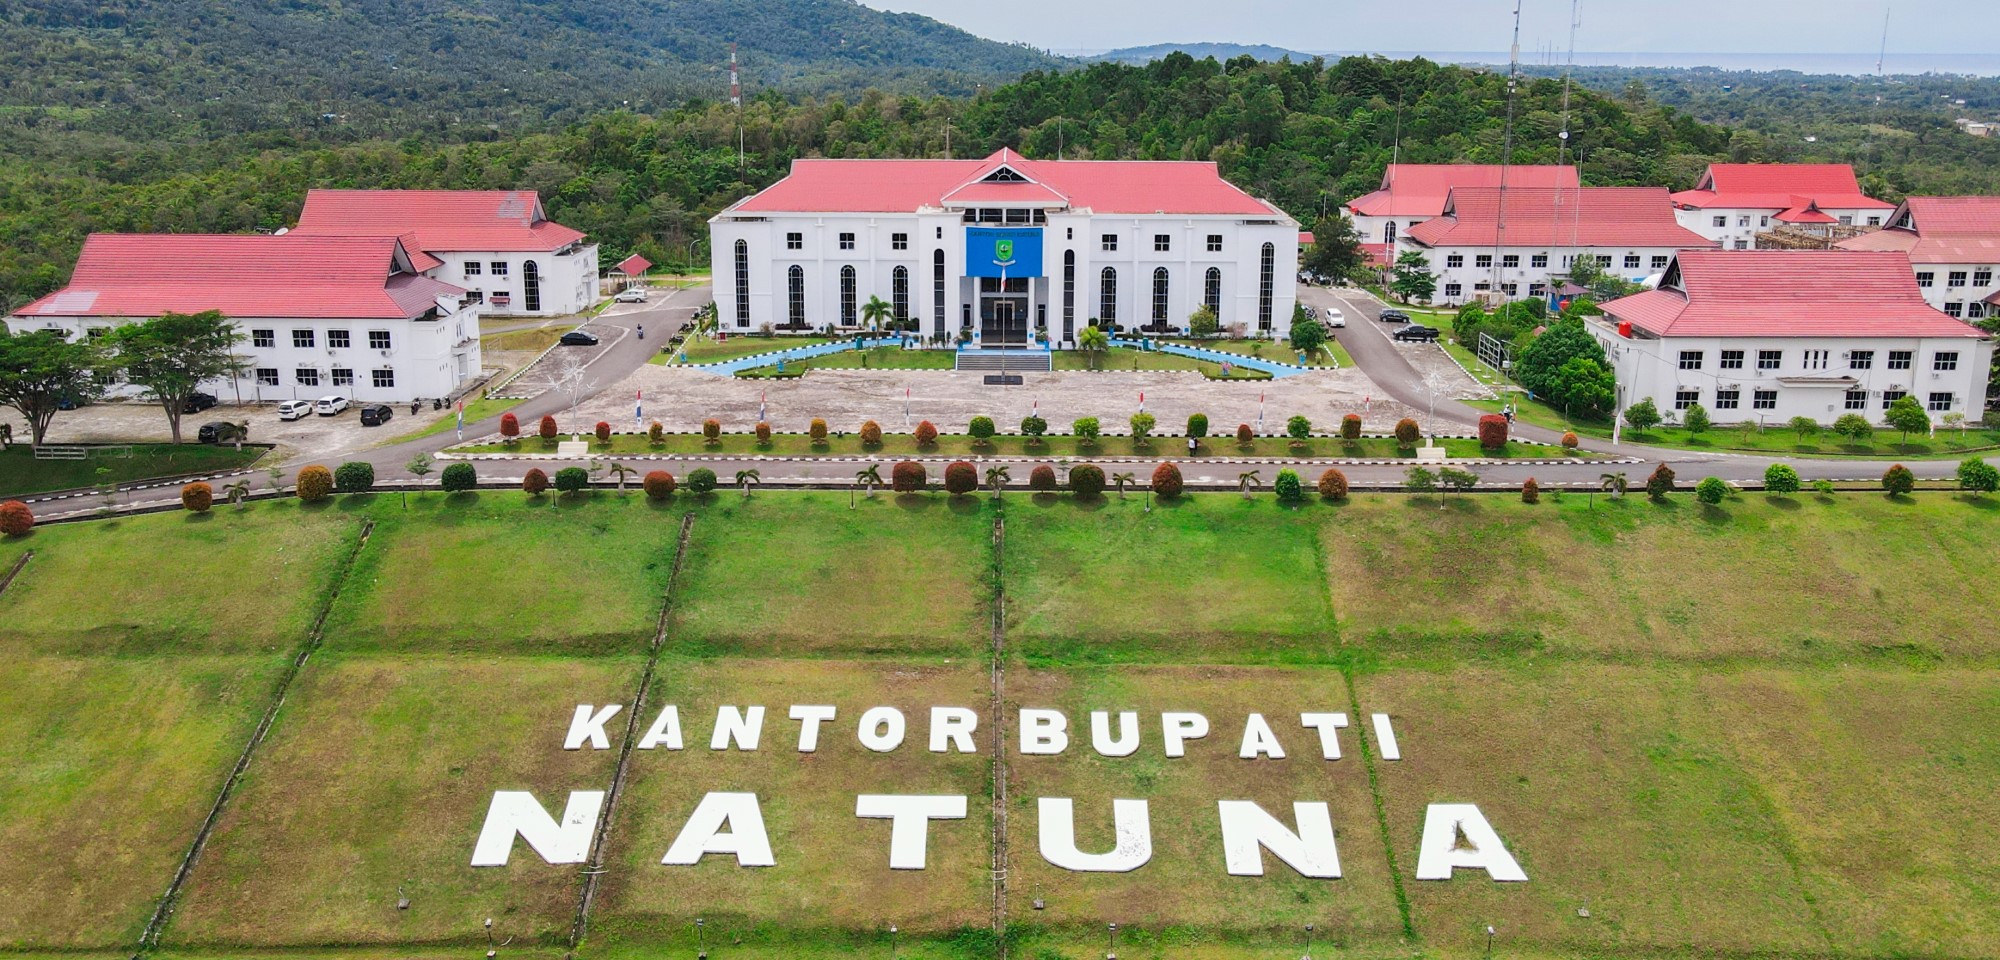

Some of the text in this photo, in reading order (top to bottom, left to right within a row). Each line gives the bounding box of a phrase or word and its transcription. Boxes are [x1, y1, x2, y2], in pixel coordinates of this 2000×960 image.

[563, 704, 1401, 761] KANTOR BUPATI
[470, 790, 1529, 883] NATUNA
